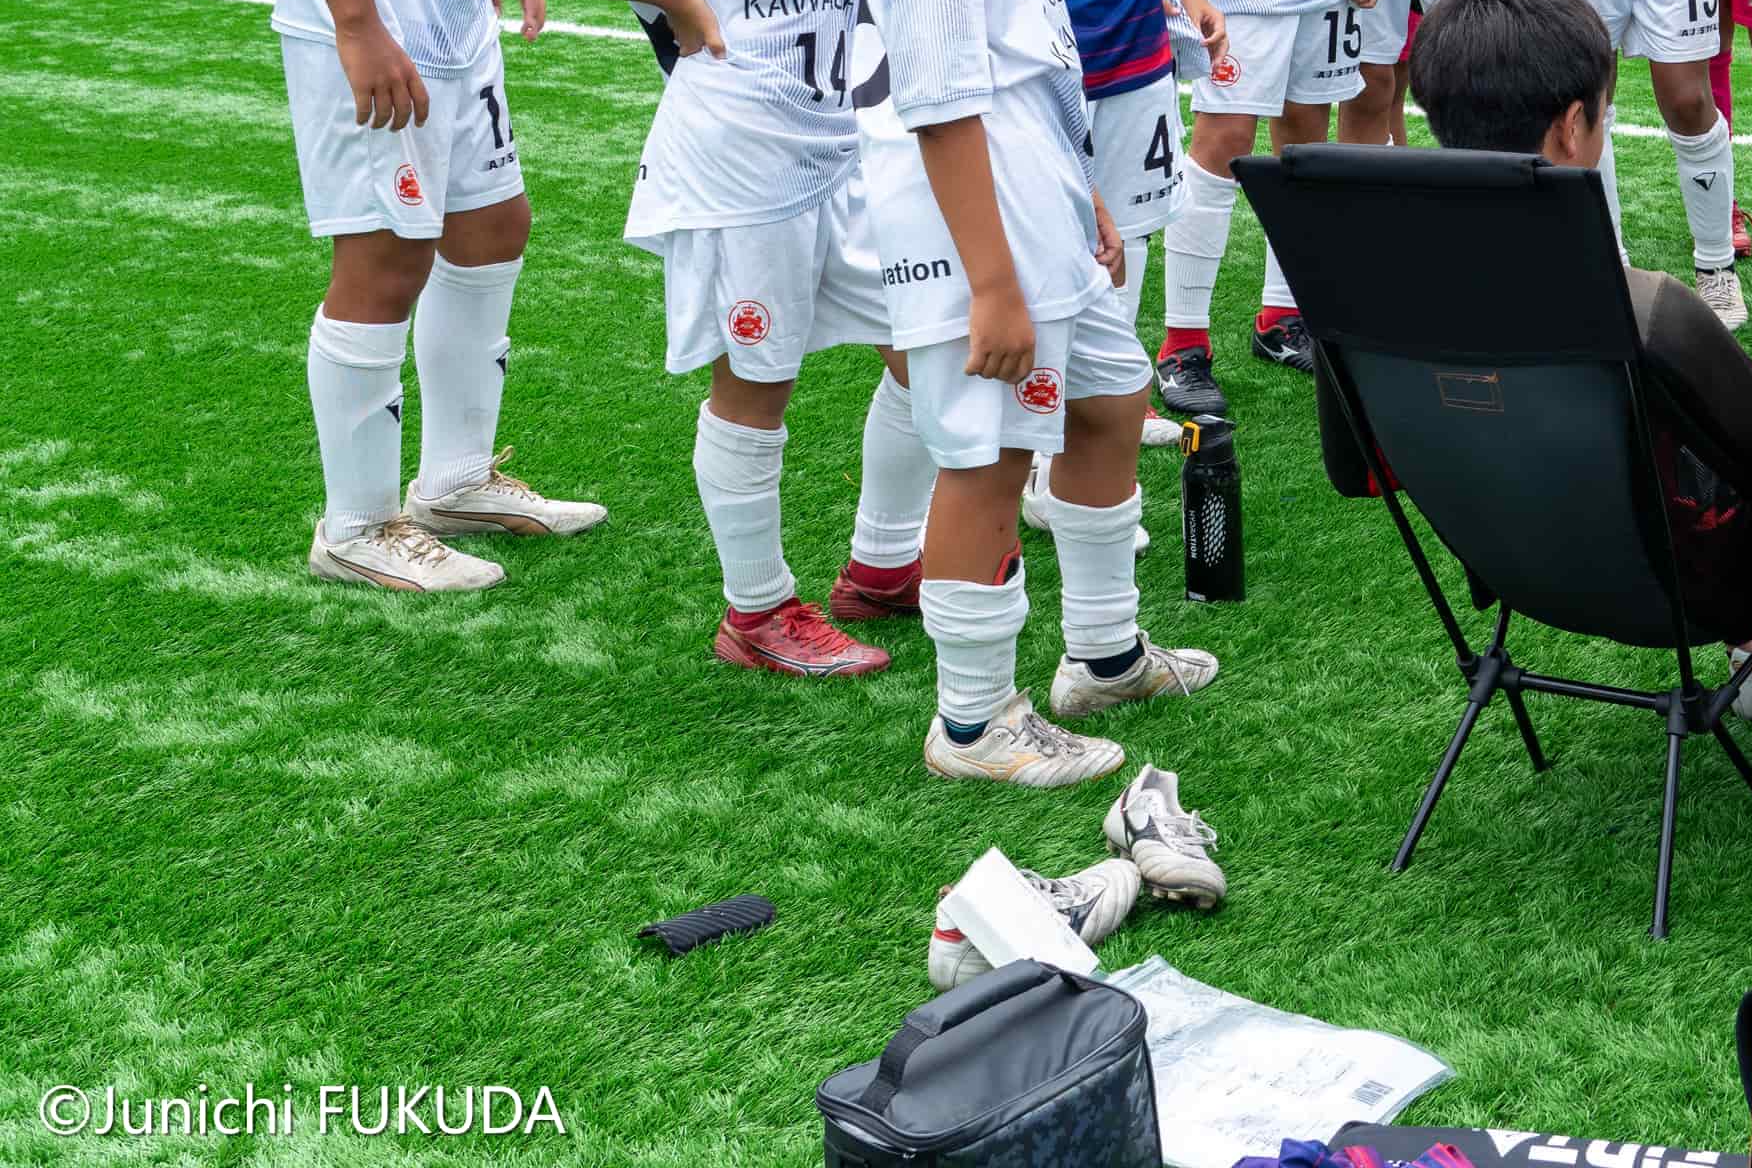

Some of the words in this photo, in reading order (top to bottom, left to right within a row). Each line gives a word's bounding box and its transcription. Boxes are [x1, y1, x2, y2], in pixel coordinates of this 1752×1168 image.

[1323, 7, 1361, 64] 15
[795, 30, 847, 108] 14
[479, 85, 514, 150] 1
[1144, 113, 1174, 179] 4
